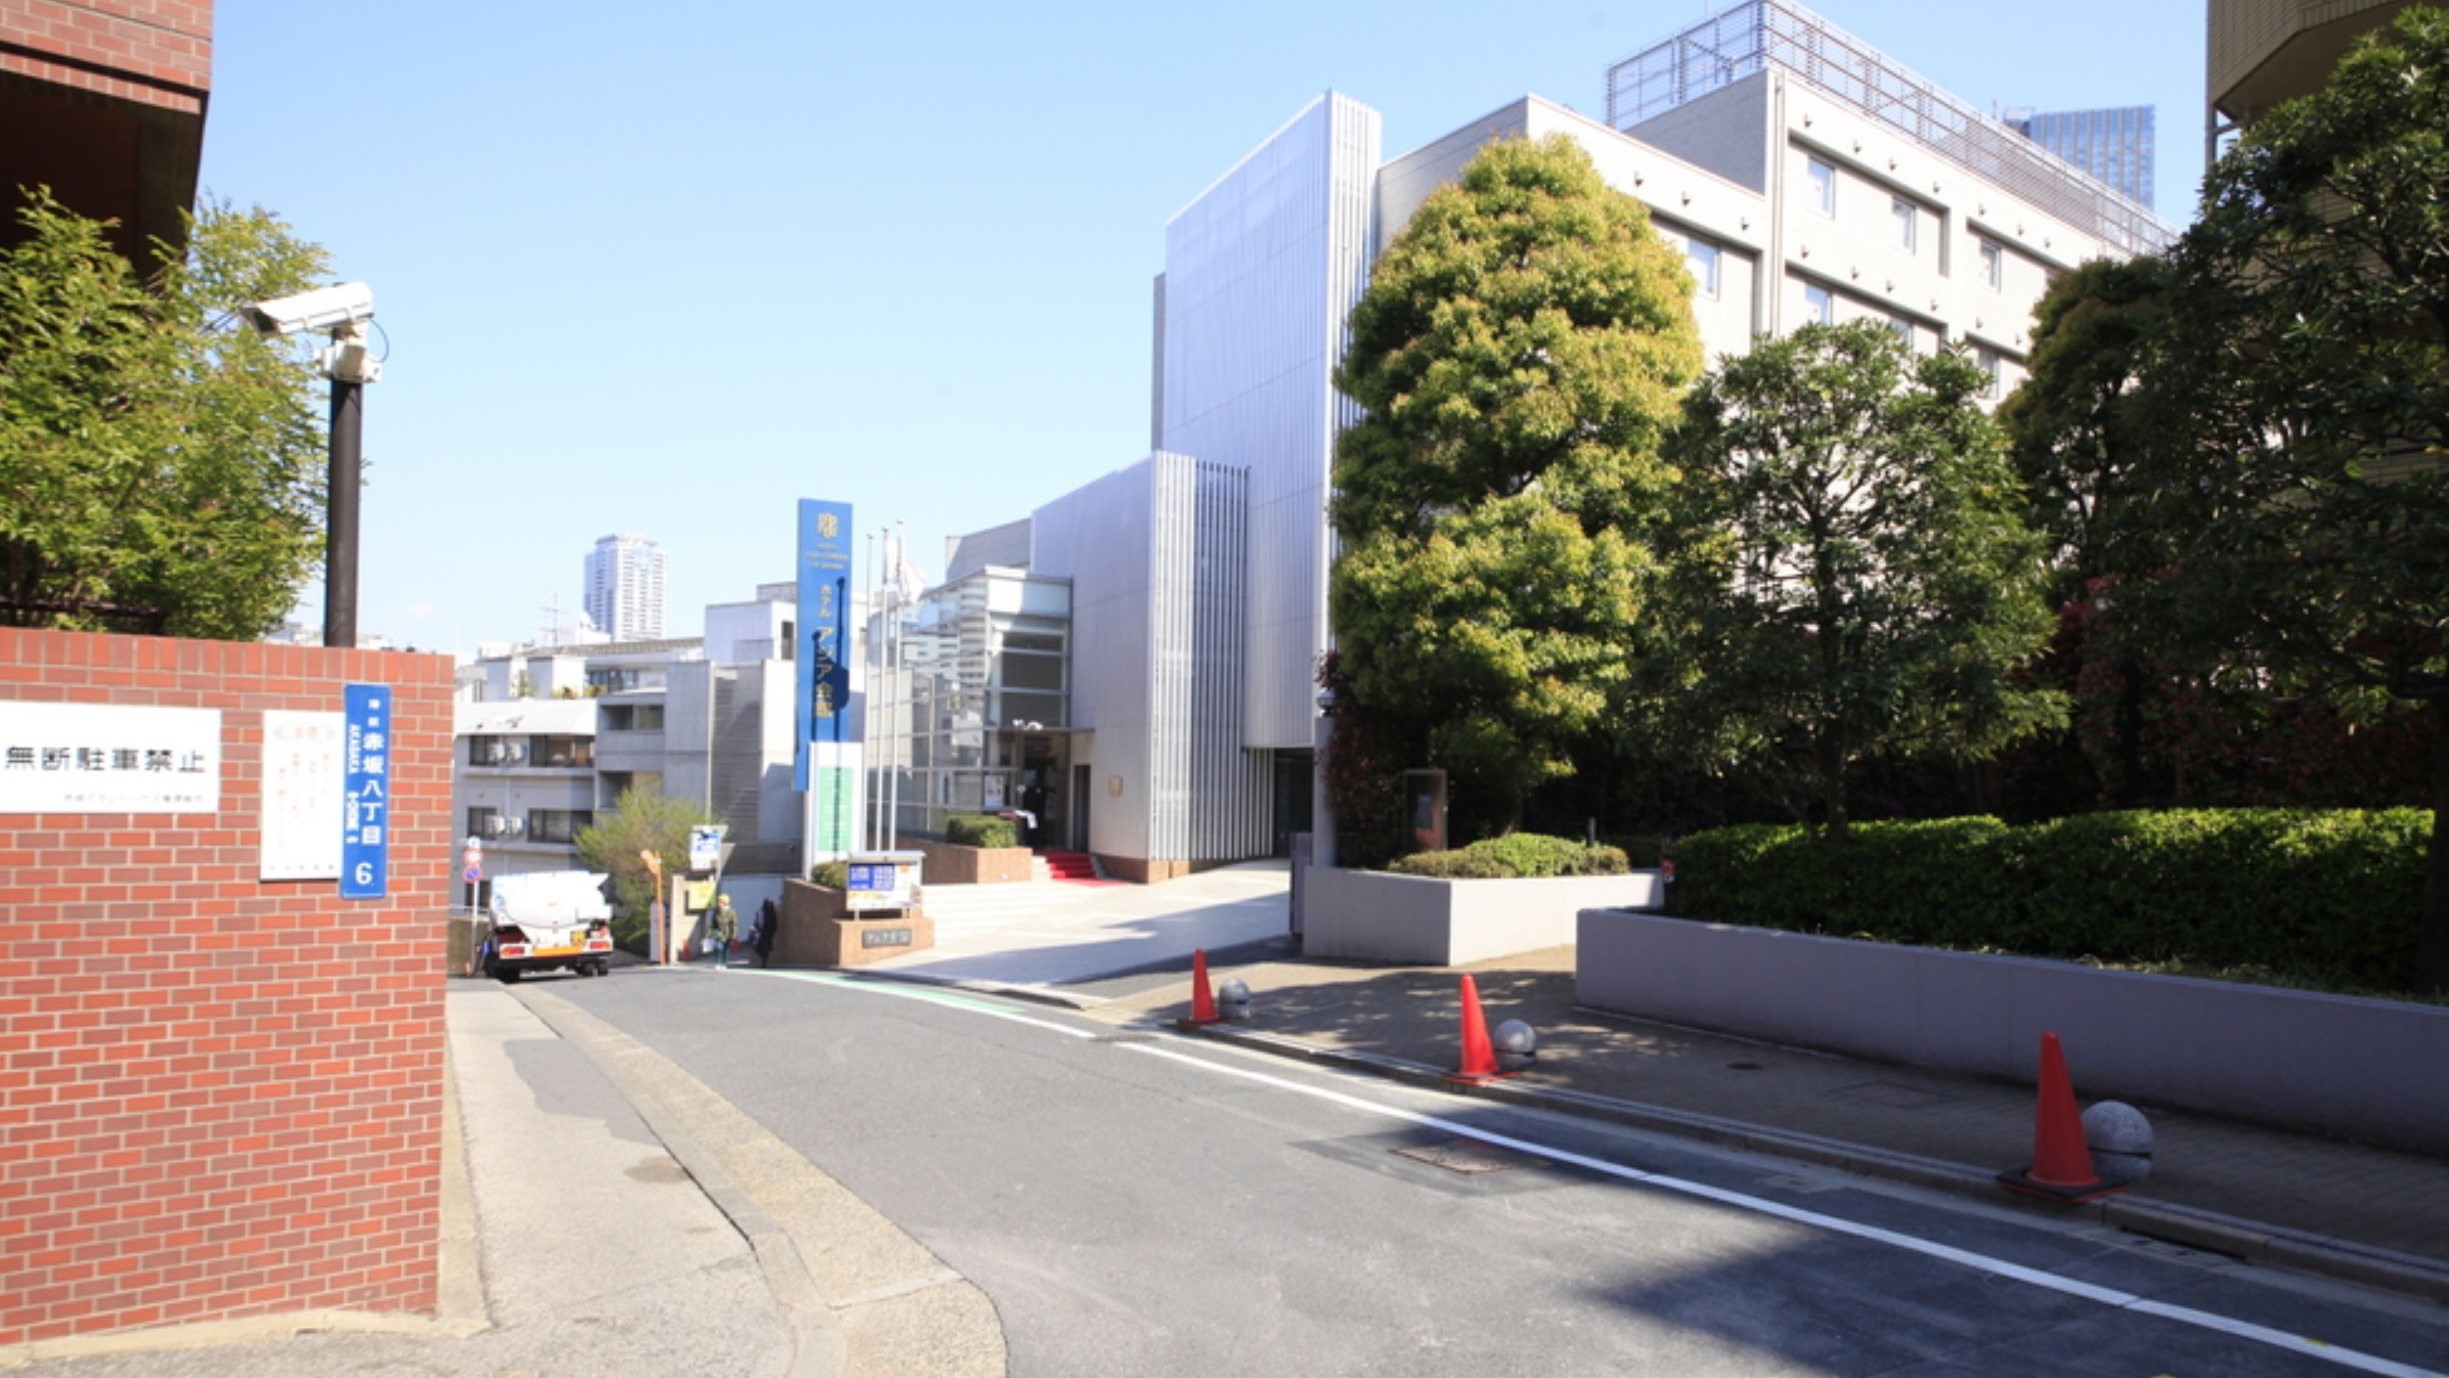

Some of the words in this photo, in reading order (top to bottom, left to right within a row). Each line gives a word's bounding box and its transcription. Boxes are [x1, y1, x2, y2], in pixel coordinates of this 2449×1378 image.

[5, 746, 206, 773] 無断駐車禁止
[355, 861, 373, 885] 6
